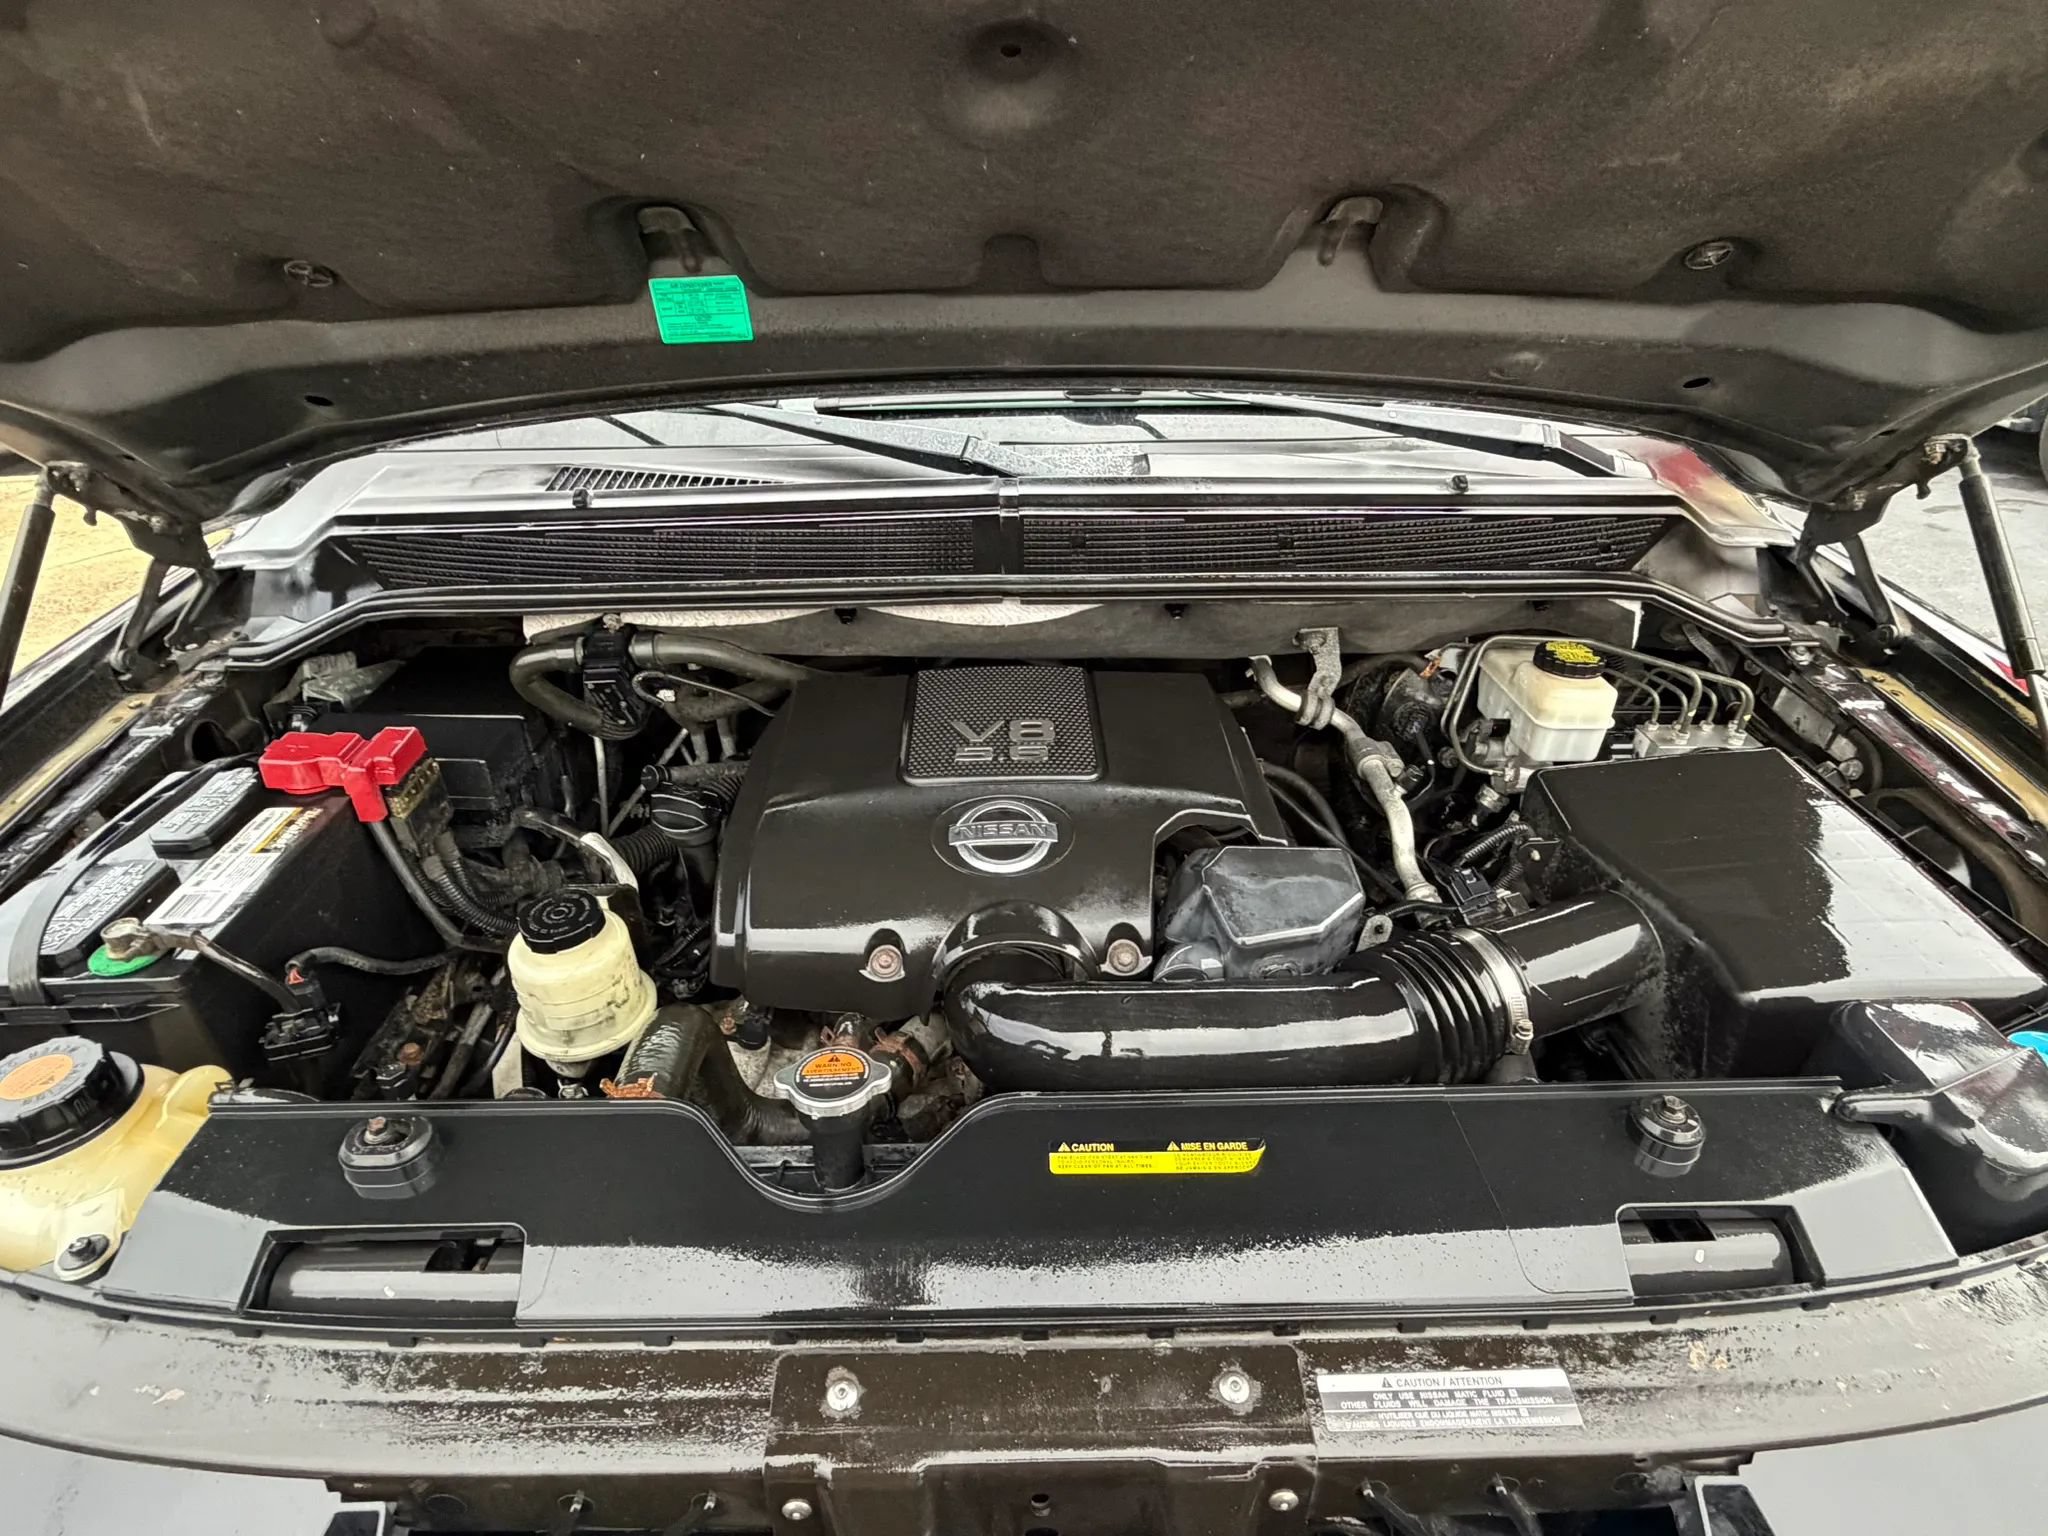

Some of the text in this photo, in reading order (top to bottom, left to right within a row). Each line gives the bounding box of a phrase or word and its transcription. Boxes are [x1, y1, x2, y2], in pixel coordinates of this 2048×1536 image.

[948, 719, 1056, 744] V8
[954, 745, 1049, 762] 5.6
[957, 823, 1046, 839] NISSAN
[1071, 1143, 1114, 1152] CAUTION
[1180, 1141, 1248, 1151] MISE EN GARDE
[1396, 1377, 1440, 1387] CAUTION
[1449, 1375, 1502, 1386] ATTENTION
[1373, 1393, 1393, 1401] ONLY
[1398, 1391, 1415, 1400] USE
[1419, 1391, 1449, 1399] NISSAN
[1453, 1390, 1477, 1398] MATIC
[1482, 1389, 1505, 1397] FLUID
[1340, 1396, 1555, 1409] OTHER FLUIDS WILL DAMAGE THE TRANSMISSION
